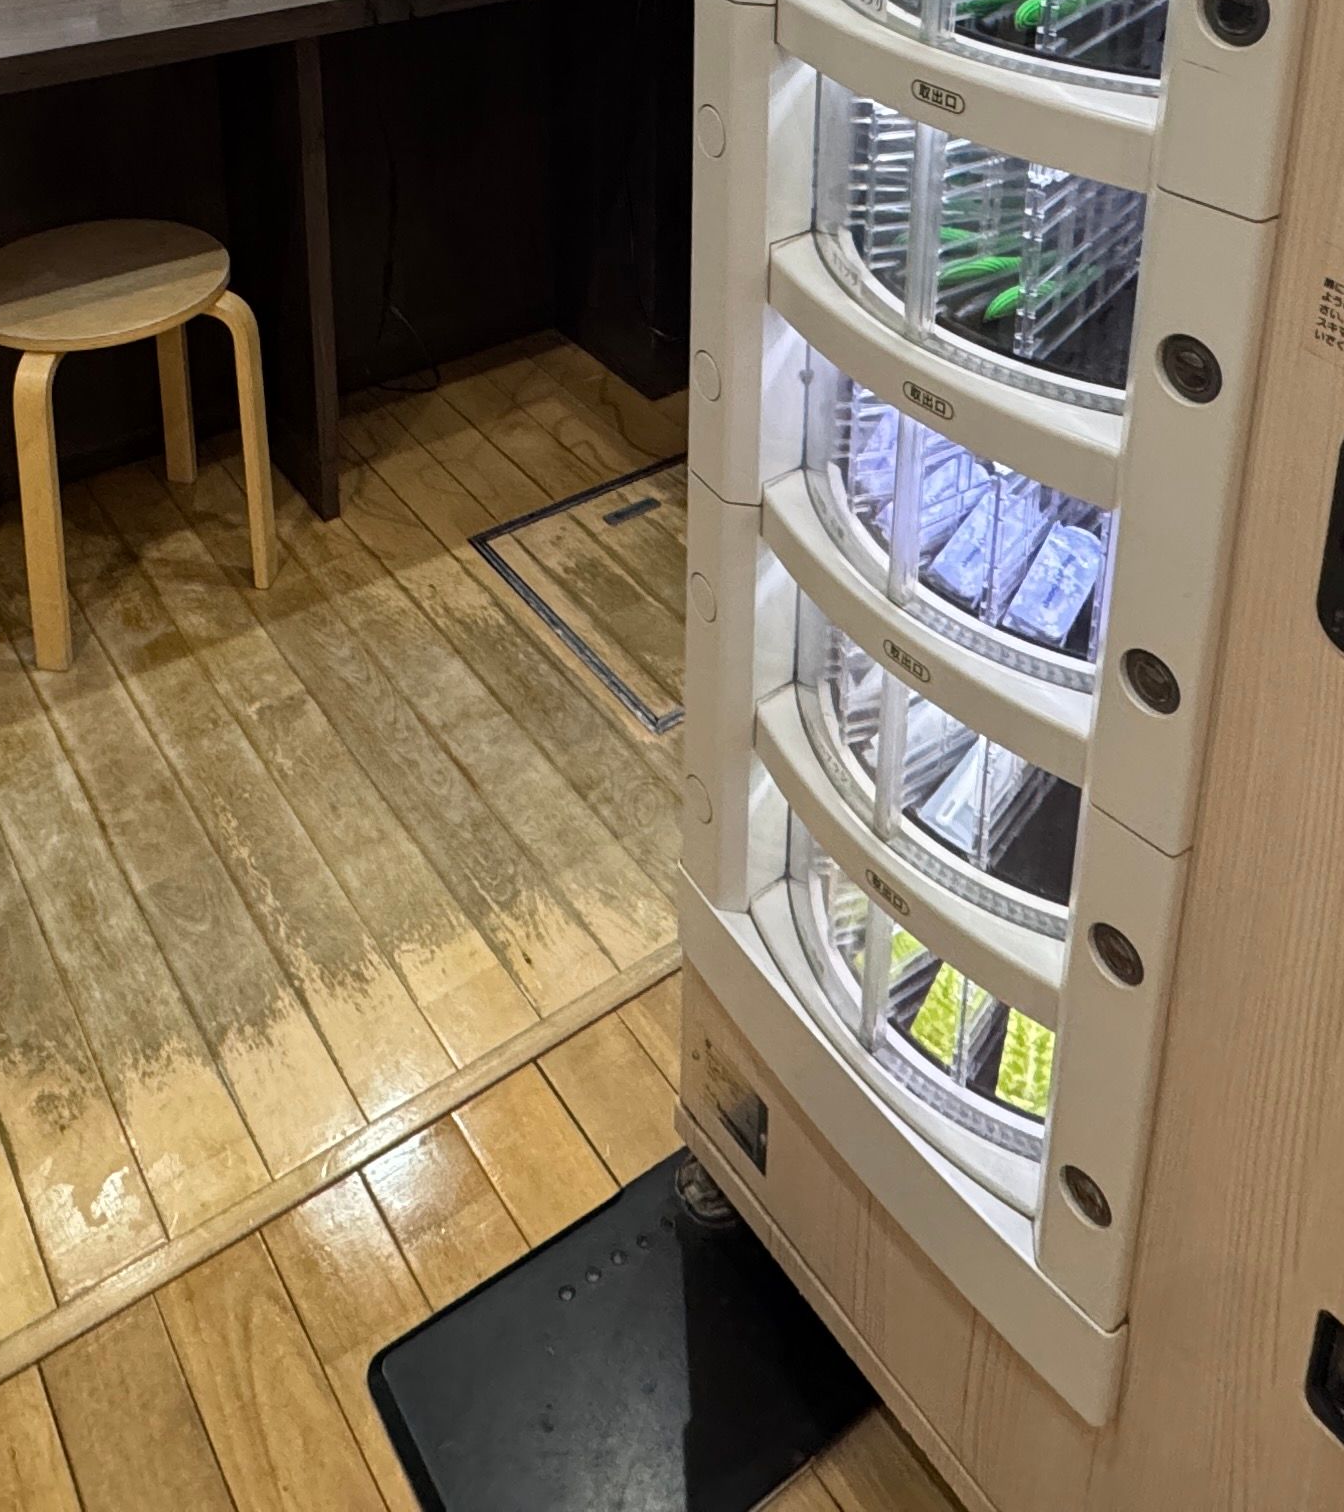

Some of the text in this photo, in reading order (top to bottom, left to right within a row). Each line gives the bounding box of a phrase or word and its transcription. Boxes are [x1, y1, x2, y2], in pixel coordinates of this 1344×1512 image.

[918, 84, 958, 109] 取出口
[910, 386, 947, 415] 取出口
[888, 644, 926, 679] 取出口
